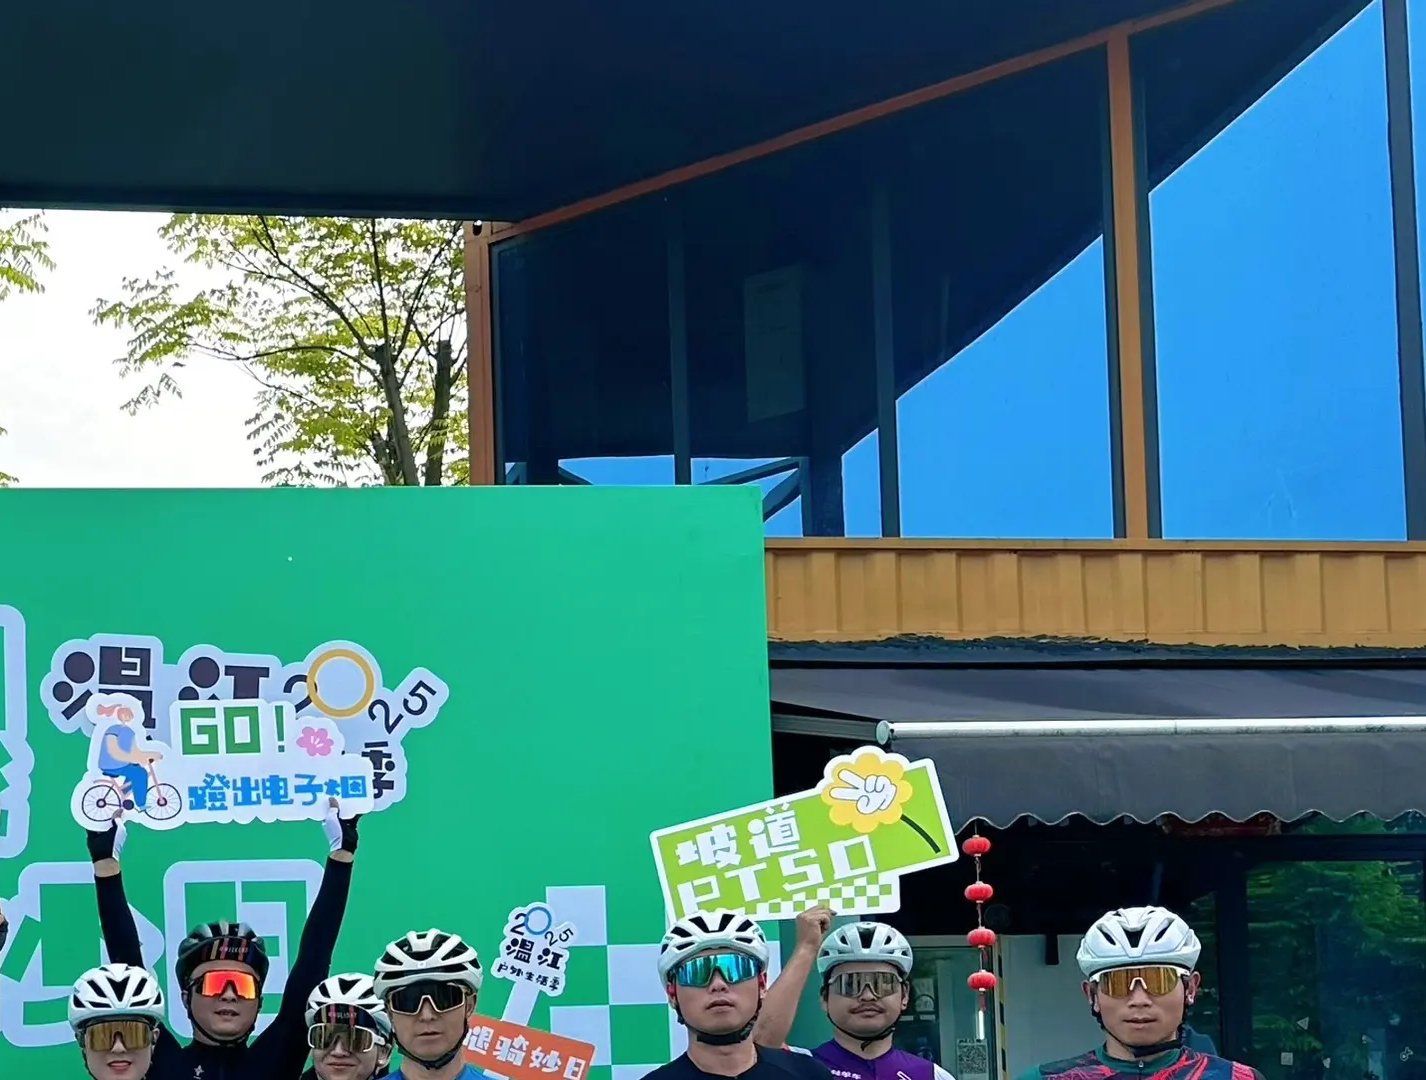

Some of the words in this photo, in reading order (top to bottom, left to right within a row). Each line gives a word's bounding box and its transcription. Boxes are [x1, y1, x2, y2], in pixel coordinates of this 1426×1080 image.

[179, 705, 286, 755] GO!
[676, 801, 801, 869] 坡道
[505, 937, 564, 971] 温江
[497, 961, 561, 991] 户外生活季
